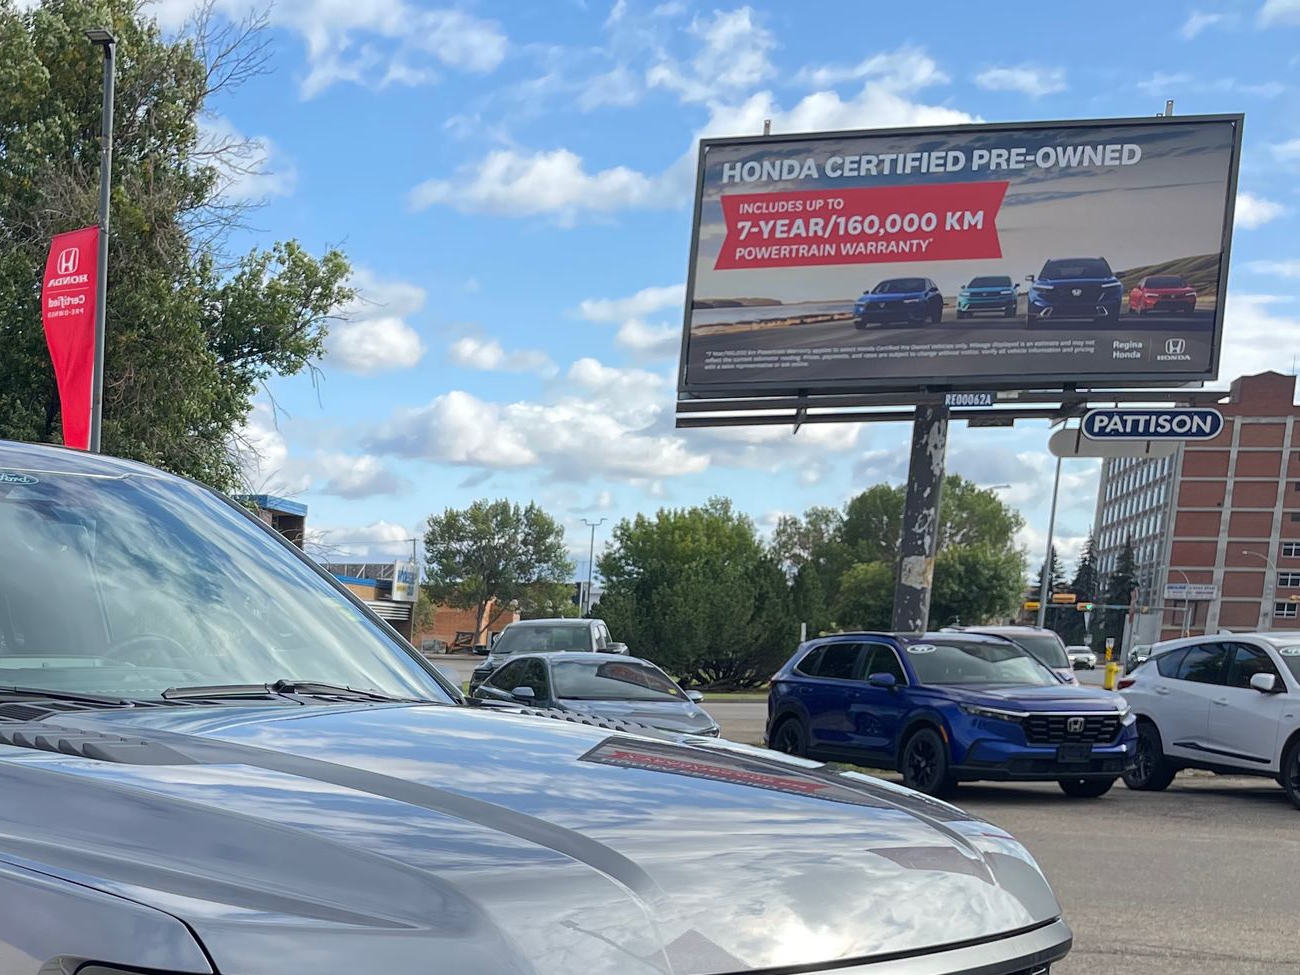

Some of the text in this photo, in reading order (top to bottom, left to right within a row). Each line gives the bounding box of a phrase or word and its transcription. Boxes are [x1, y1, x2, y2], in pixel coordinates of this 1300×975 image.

[721, 143, 1142, 184] HONDA CERTIFIED PRE-OWNED
[739, 198, 844, 215] INCLUDES UP TO
[737, 210, 984, 240] 7-YEAR/160,000 KM
[735, 243, 836, 260] POWERTRAIN
[1113, 340, 1143, 350] Regina
[1112, 350, 1141, 359] Honda
[945, 394, 992, 406] RE00062A
[1093, 414, 1213, 433] PATTISON
